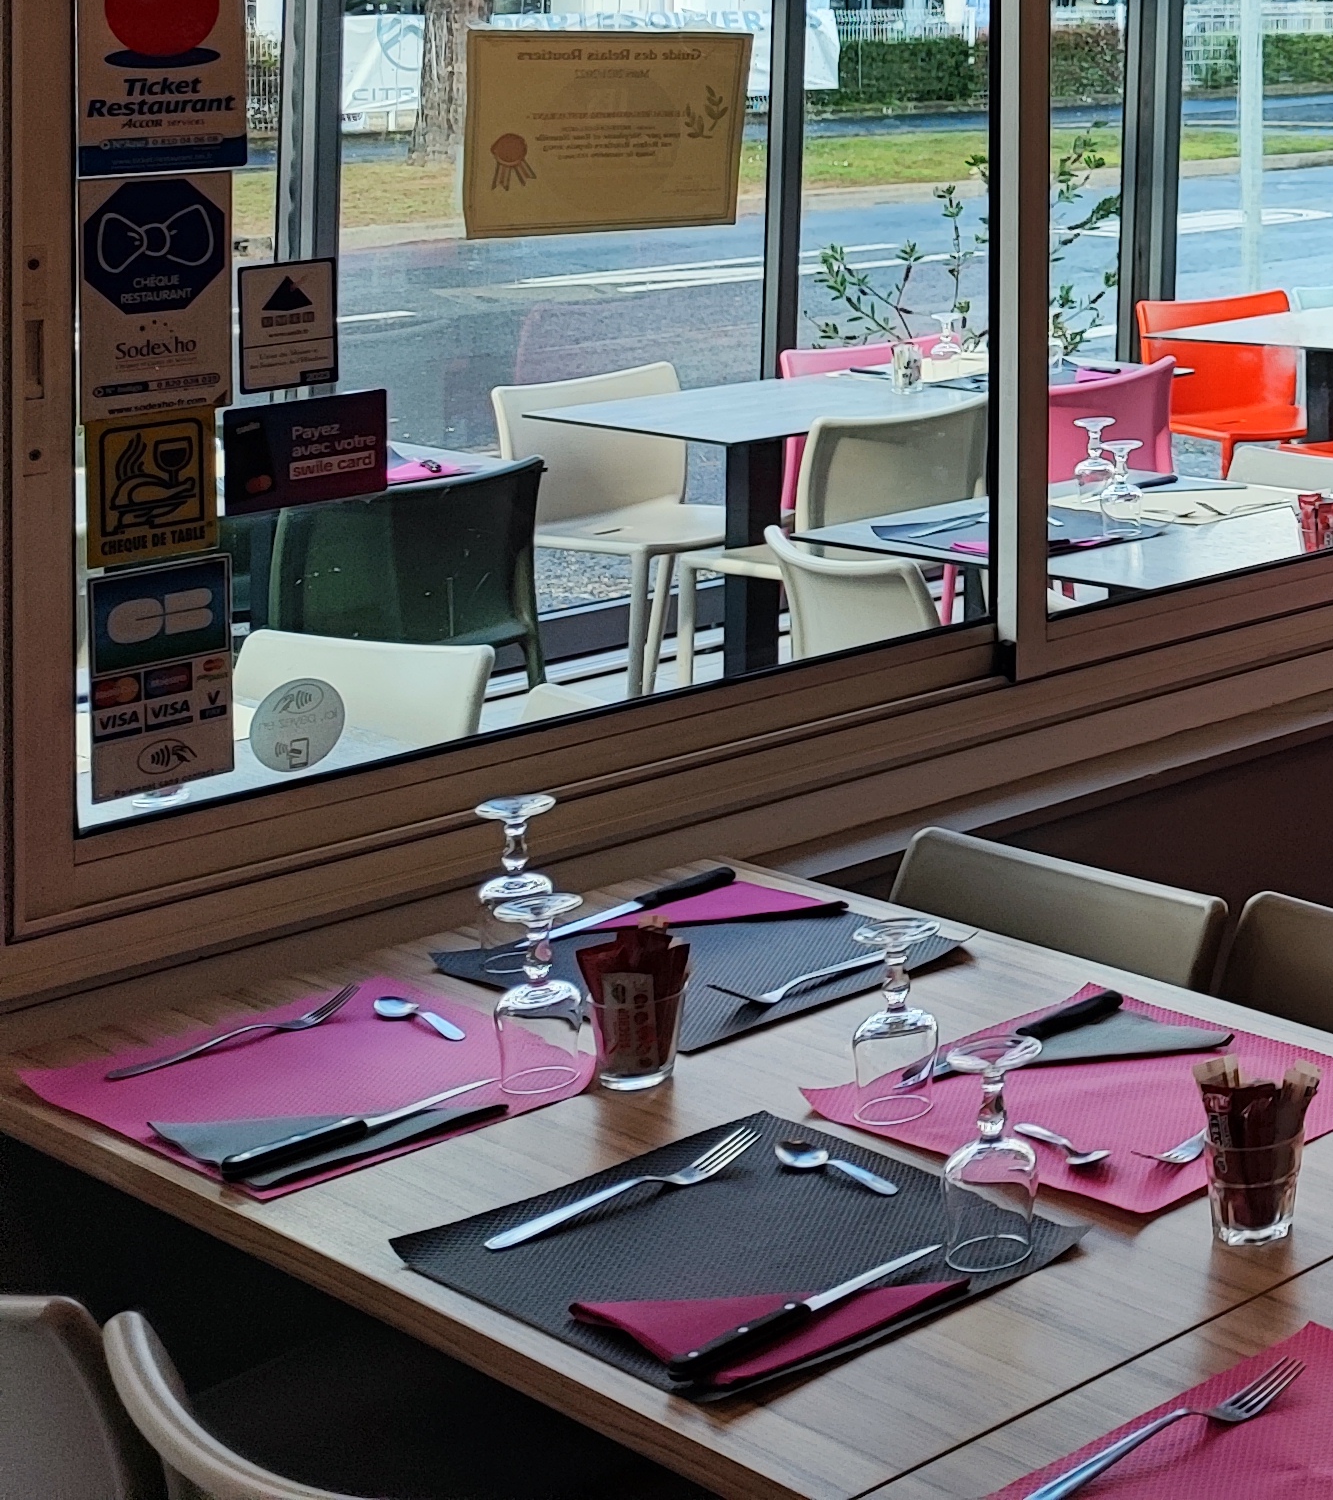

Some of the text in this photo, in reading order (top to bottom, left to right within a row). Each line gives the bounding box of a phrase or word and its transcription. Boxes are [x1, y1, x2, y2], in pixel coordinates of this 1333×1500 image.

[123, 77, 202, 97] Ticket
[352, 86, 415, 101] CITR
[87, 95, 236, 118] Restaurant
[132, 274, 181, 289] CHÈQUE
[120, 288, 193, 304] RESTAURANT
[115, 336, 197, 360] Sodexho
[291, 424, 341, 441] Payez
[291, 435, 377, 457] avec votre
[293, 453, 372, 477] swile card
[152, 532, 167, 547] DE
[171, 526, 206, 544] TABLE
[150, 700, 190, 719] VISA
[99, 710, 139, 730] VISA
